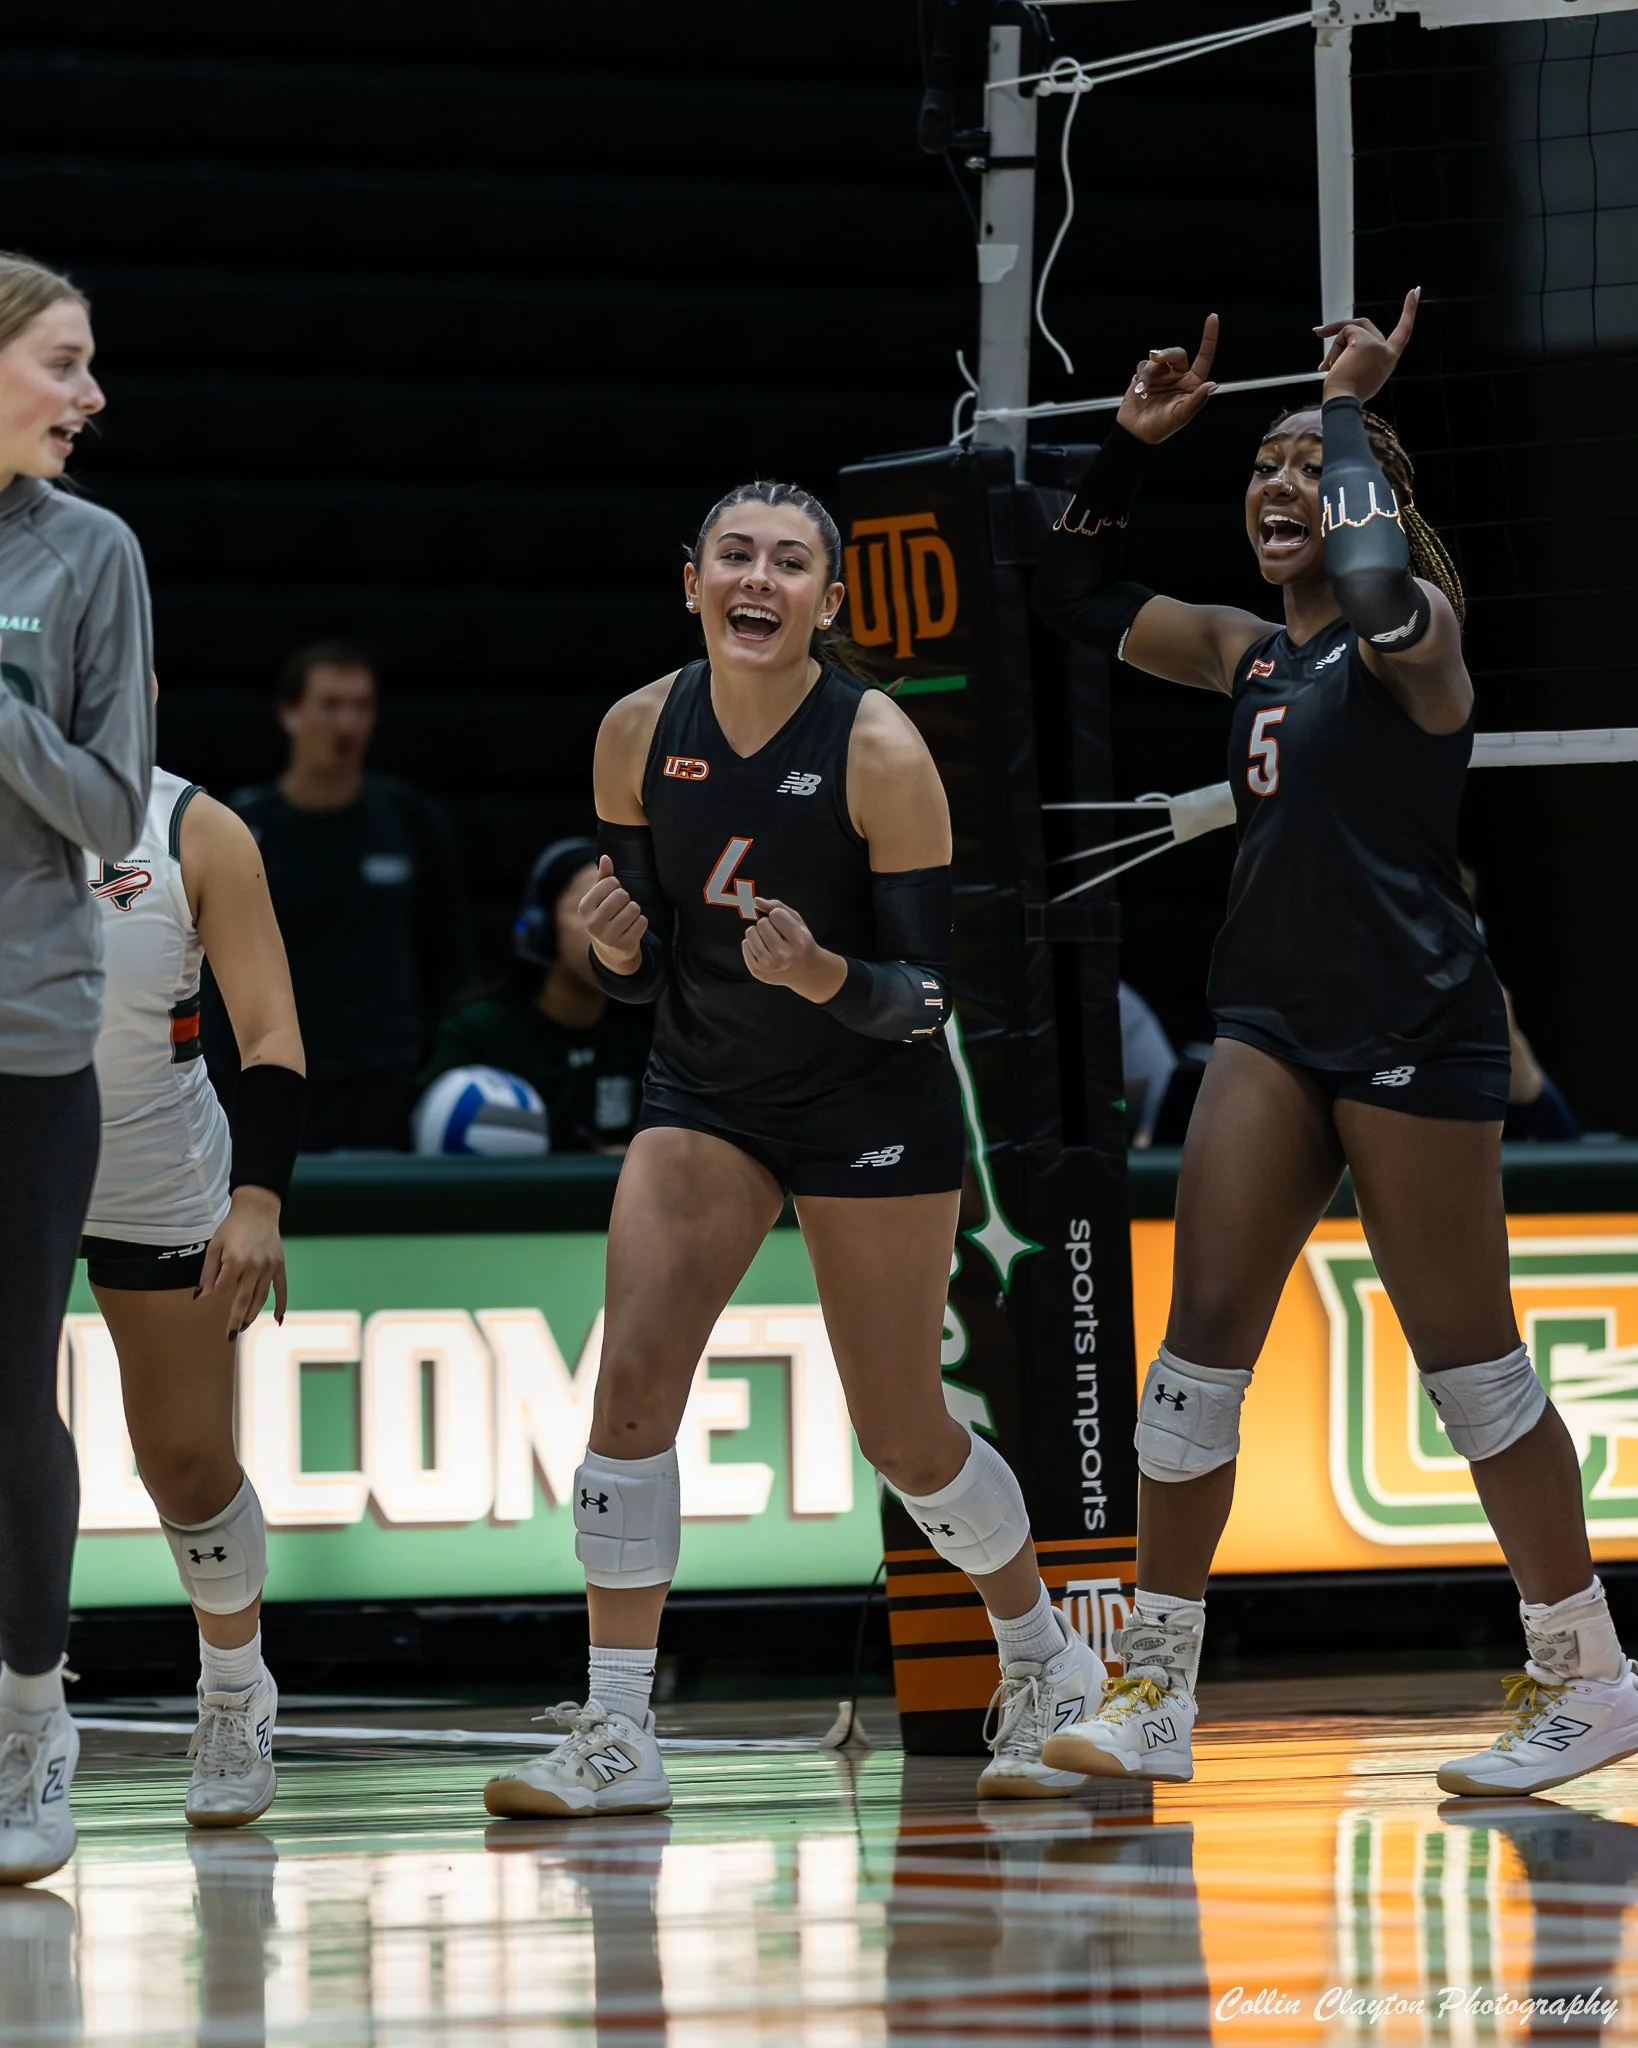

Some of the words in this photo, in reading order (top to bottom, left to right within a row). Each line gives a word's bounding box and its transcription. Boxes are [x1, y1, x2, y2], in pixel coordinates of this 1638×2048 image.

[844, 512, 959, 660] UTD
[1246, 705, 1287, 798] 5
[703, 836, 760, 920] 4
[1064, 1218, 1099, 1356] sports
[1072, 1363, 1108, 1531] imports
